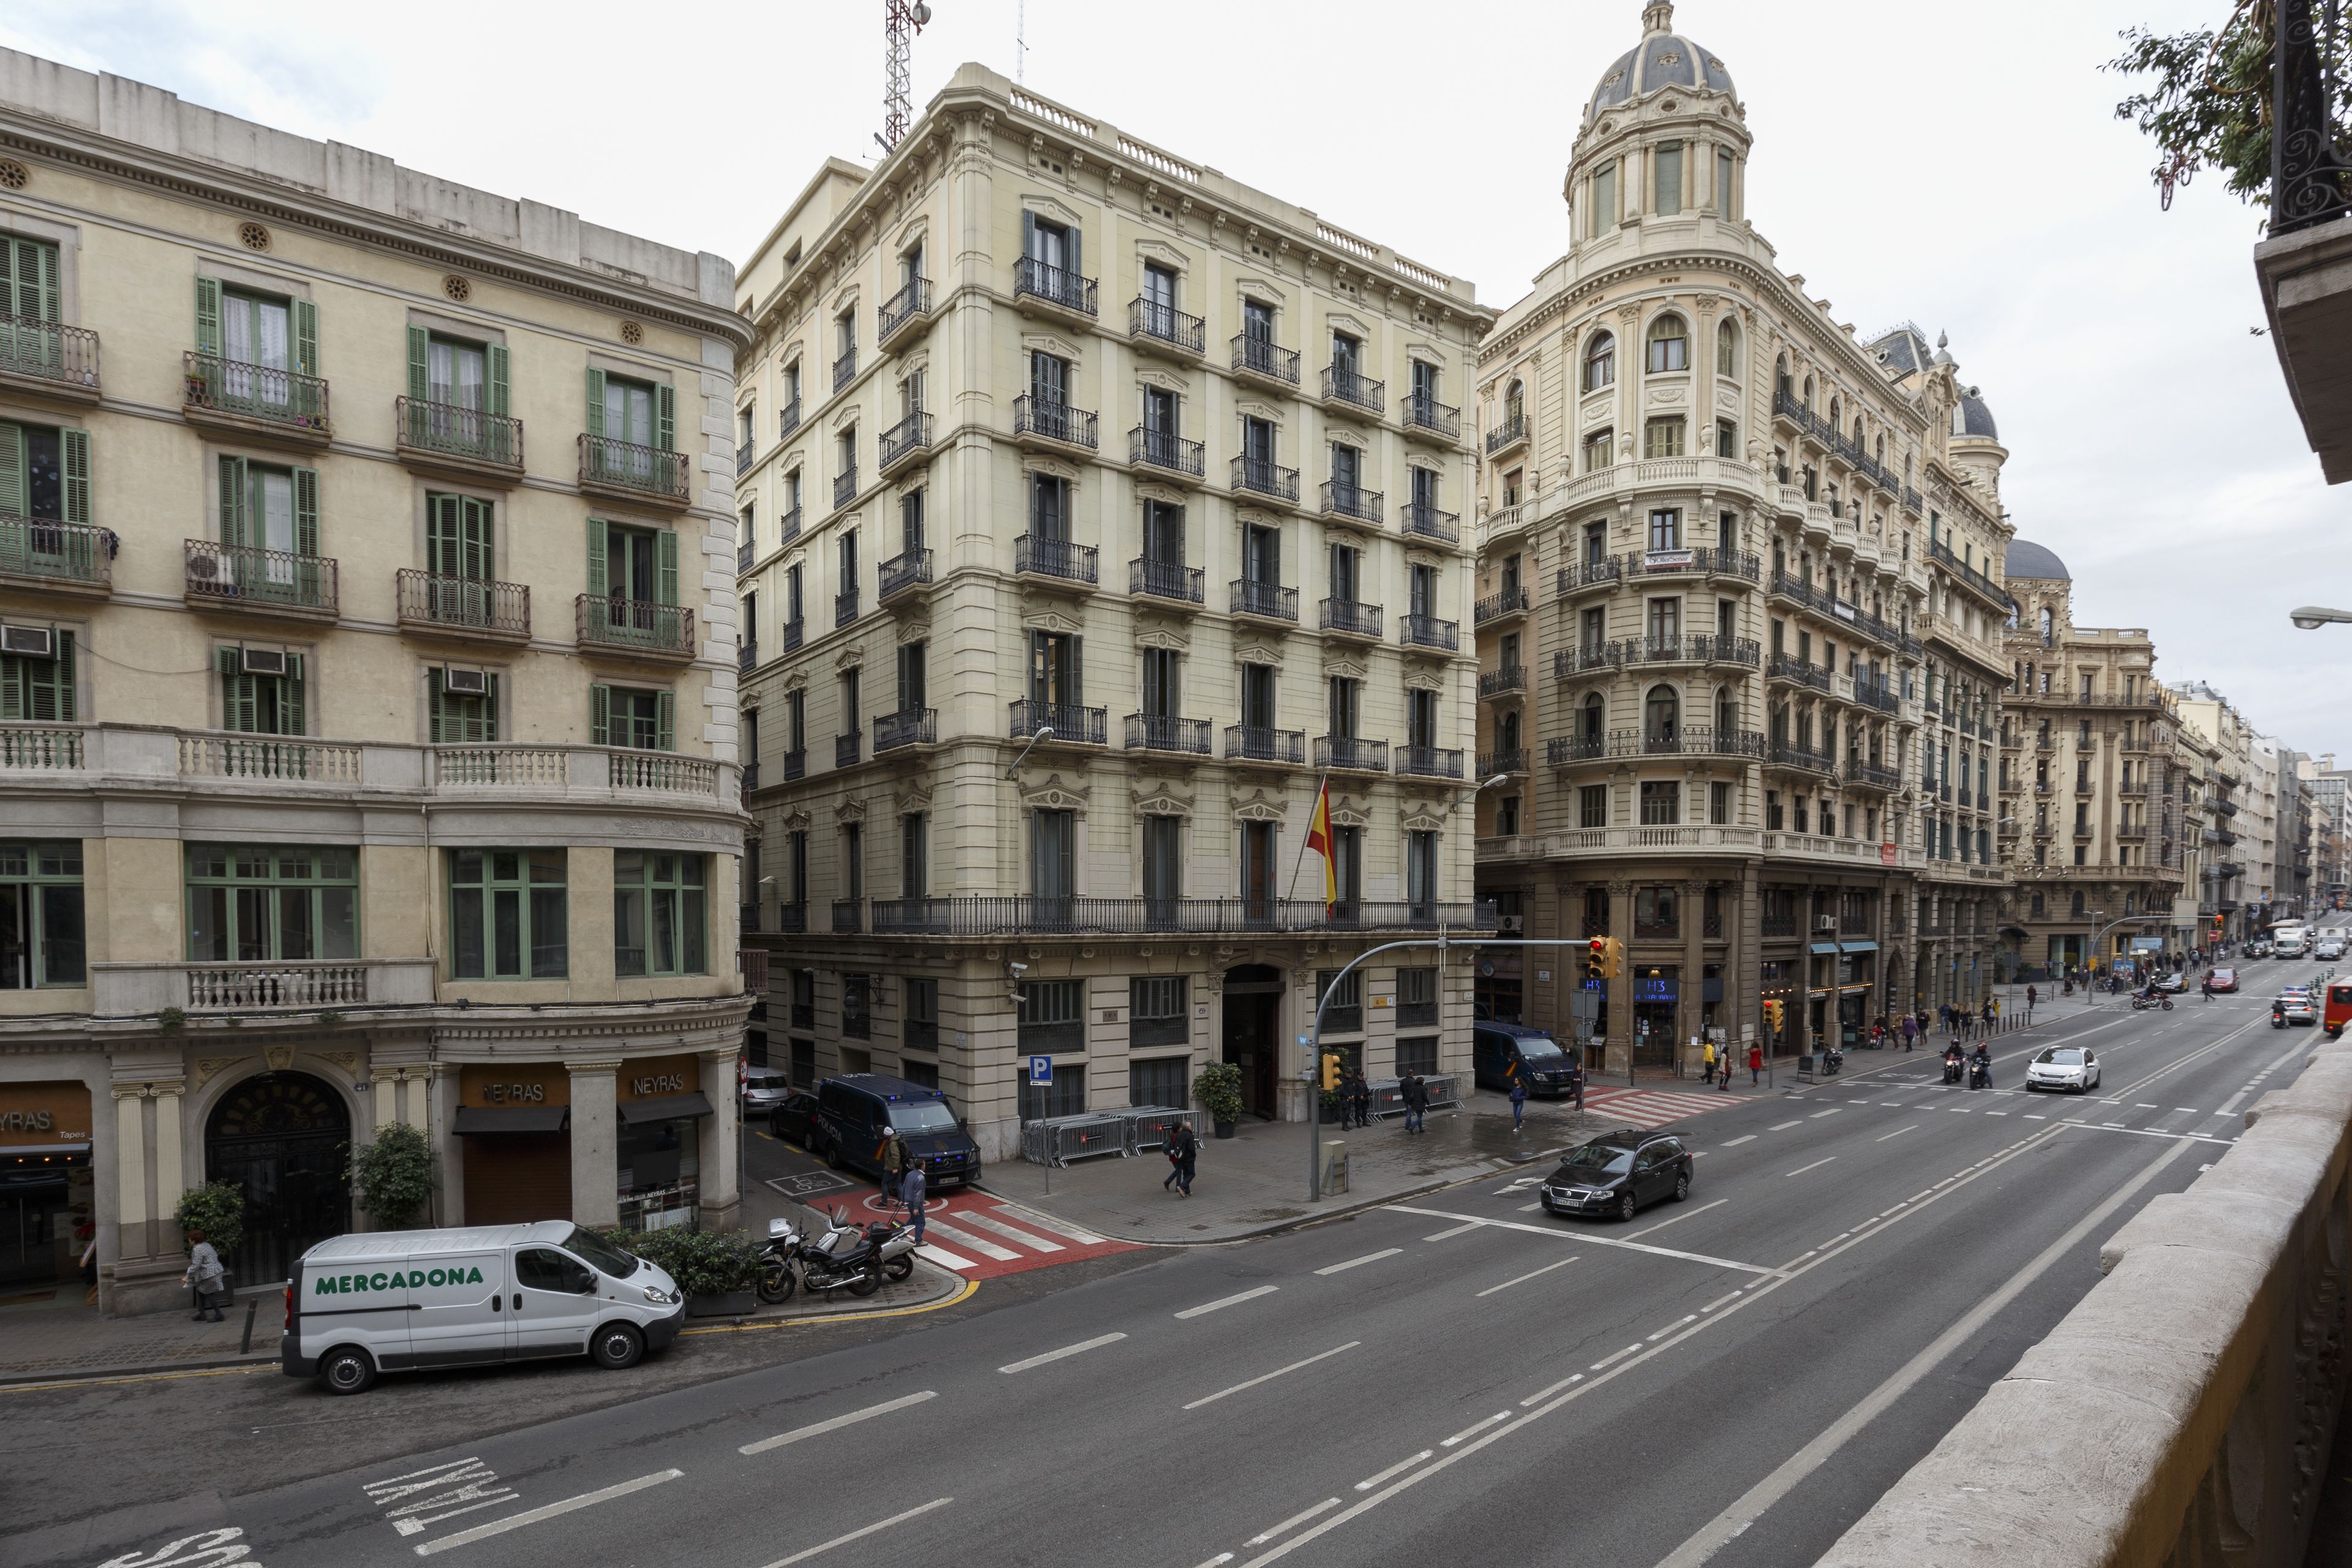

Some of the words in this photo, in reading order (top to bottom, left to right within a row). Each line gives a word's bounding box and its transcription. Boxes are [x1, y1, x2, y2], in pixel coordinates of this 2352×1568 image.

[1648, 980, 1665, 992] H3
[1034, 1058, 1047, 1078] P
[482, 1084, 543, 1101] NEYRAS
[634, 1074, 684, 1095] NEYRAS
[59, 1131, 86, 1140] Tapes
[818, 1114, 843, 1144] POLICIA
[647, 1189, 666, 1199] NEYRAS
[315, 1266, 484, 1295] MERCADONA
